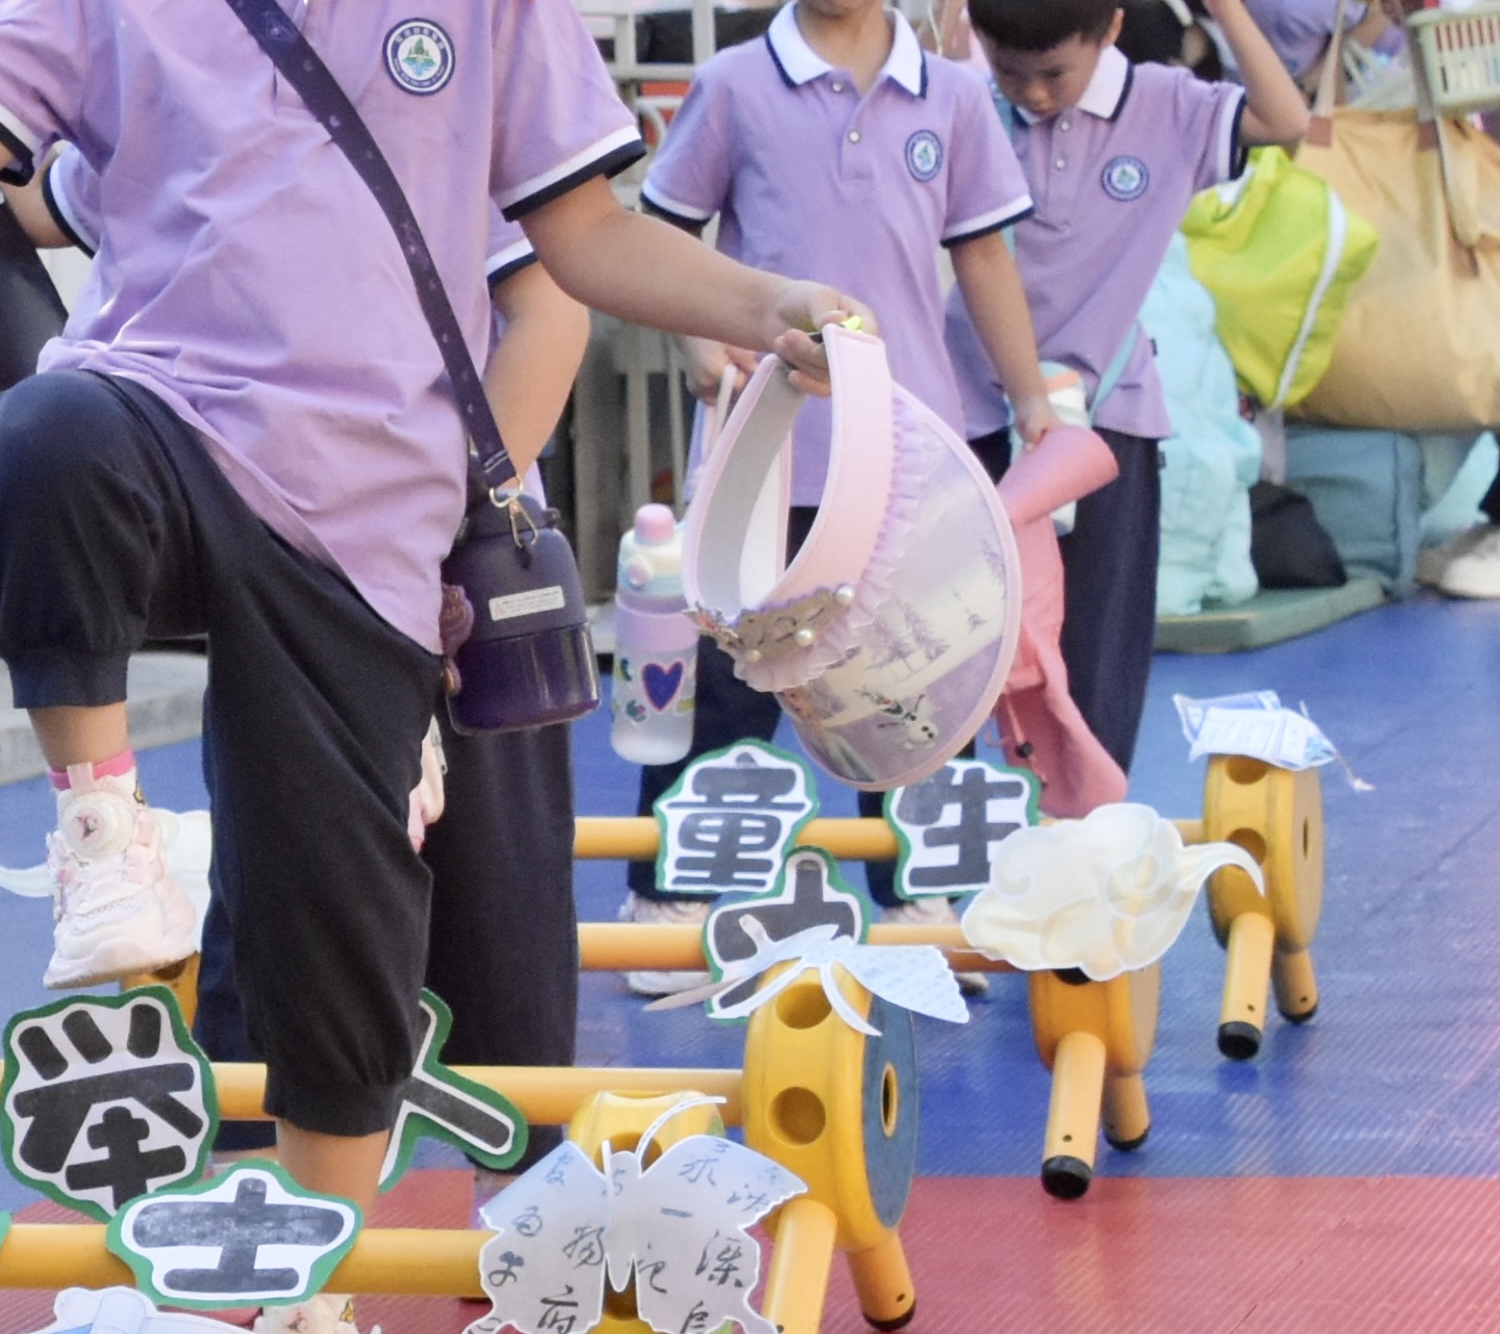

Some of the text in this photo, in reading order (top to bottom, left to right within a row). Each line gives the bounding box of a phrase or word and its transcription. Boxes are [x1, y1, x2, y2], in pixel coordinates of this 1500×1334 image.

[666, 752, 805, 887] 童
[896, 767, 1024, 888] 生
[13, 1003, 204, 1211] 举
[132, 1178, 345, 1293] 士
